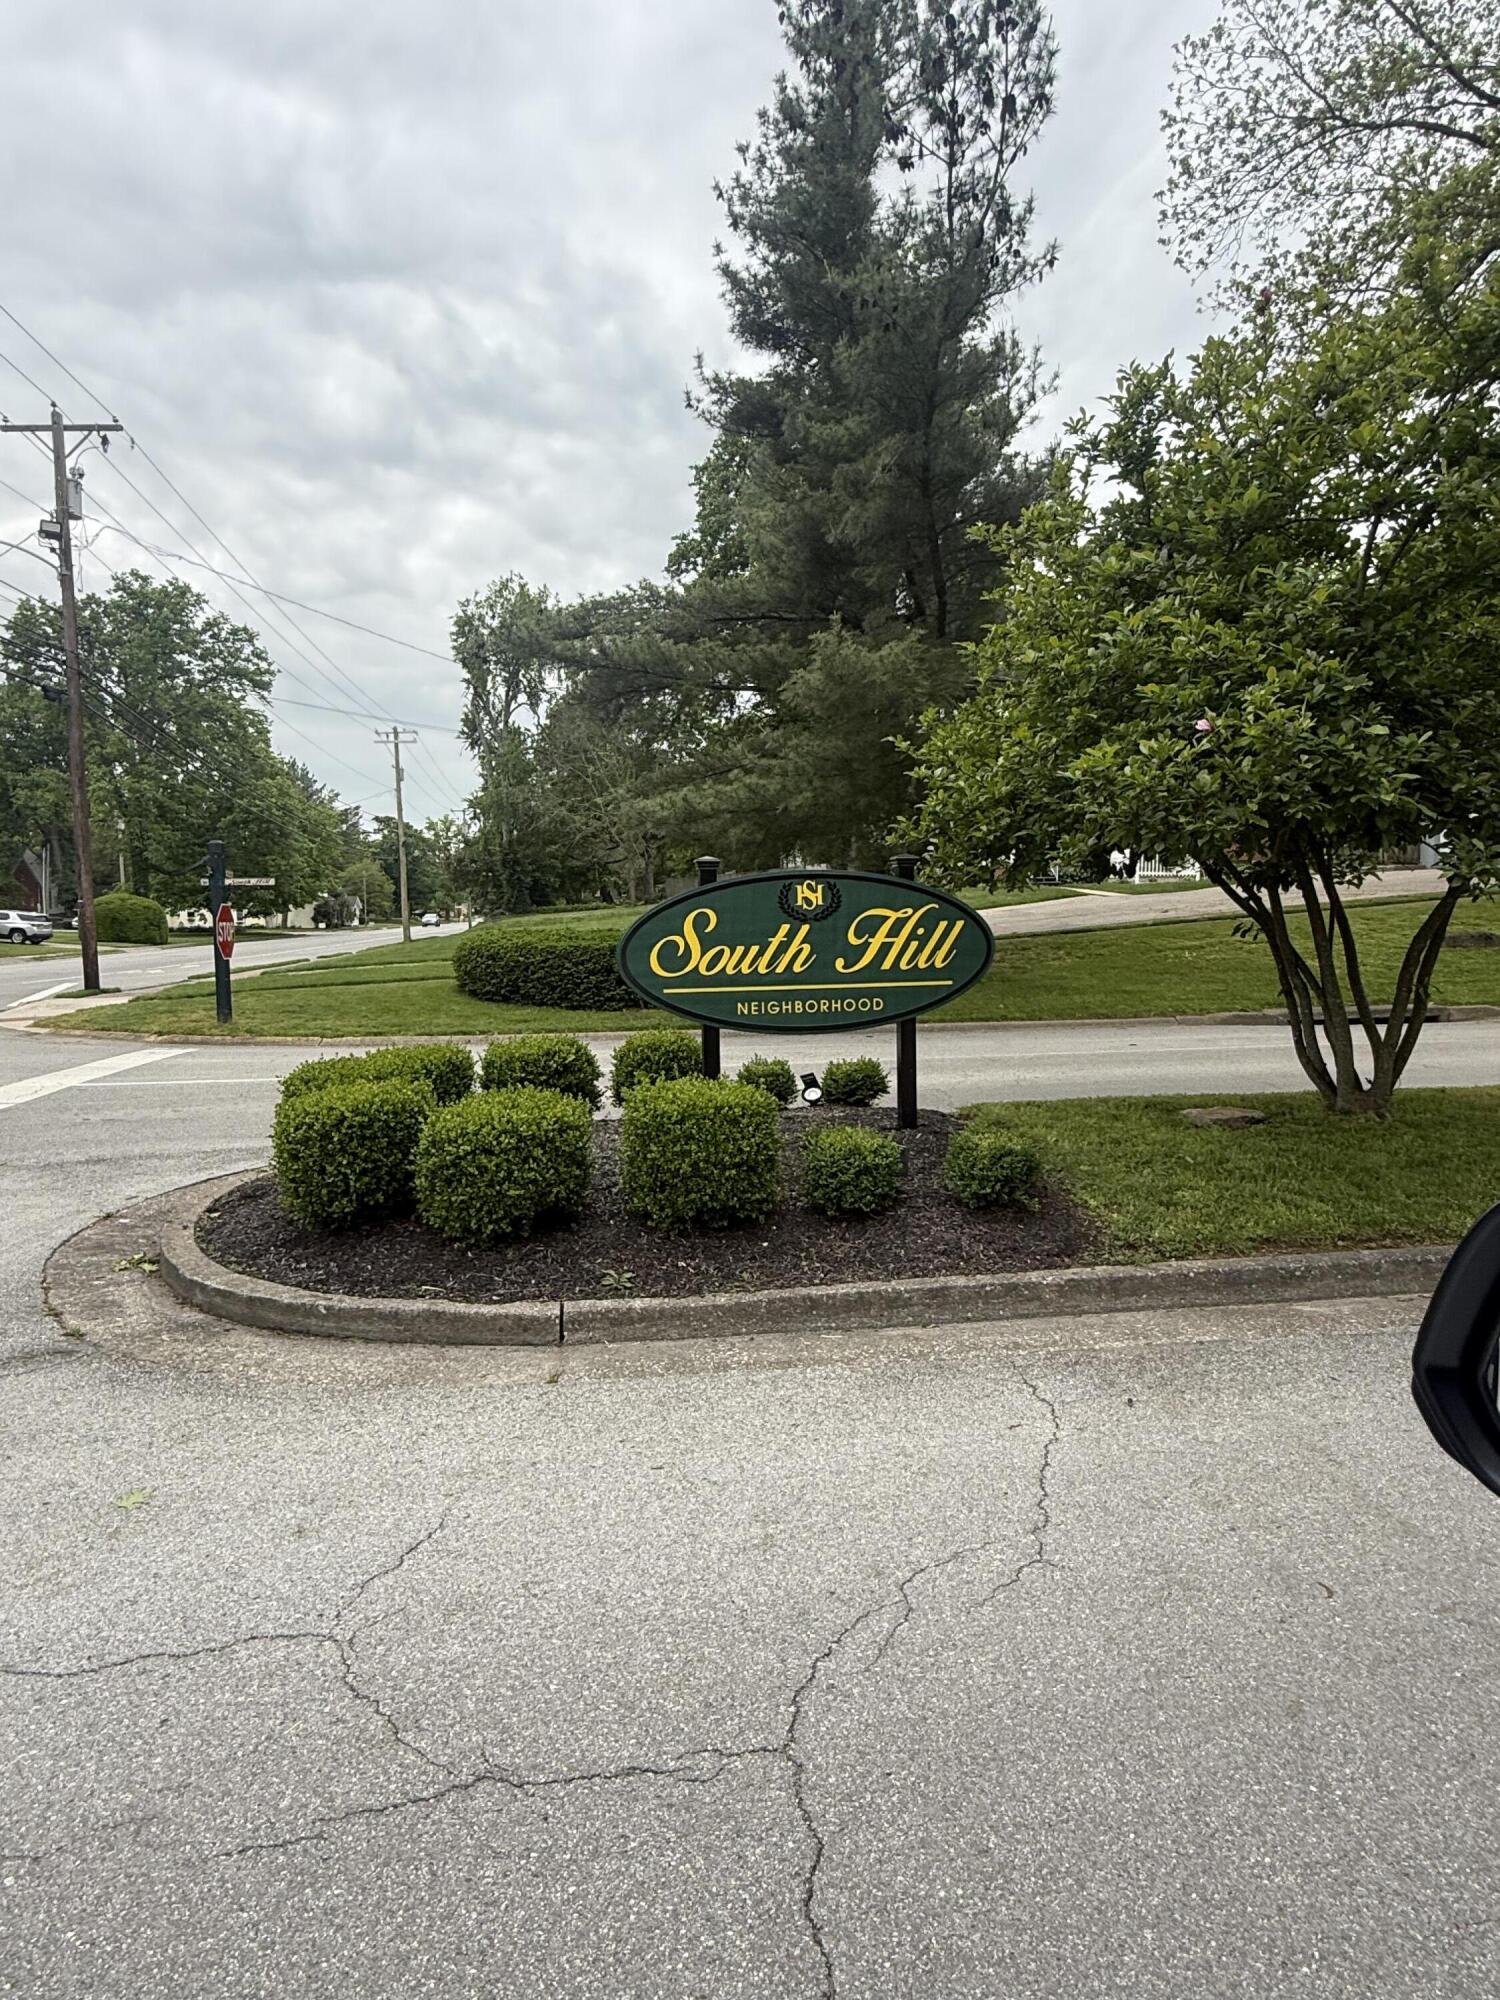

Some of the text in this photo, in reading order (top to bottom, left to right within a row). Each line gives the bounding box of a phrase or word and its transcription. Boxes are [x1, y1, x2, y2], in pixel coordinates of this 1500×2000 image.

[218, 922, 235, 942] STOP
[649, 903, 965, 978] South Hill
[737, 997, 884, 1016] NEIGHBORHOOD
